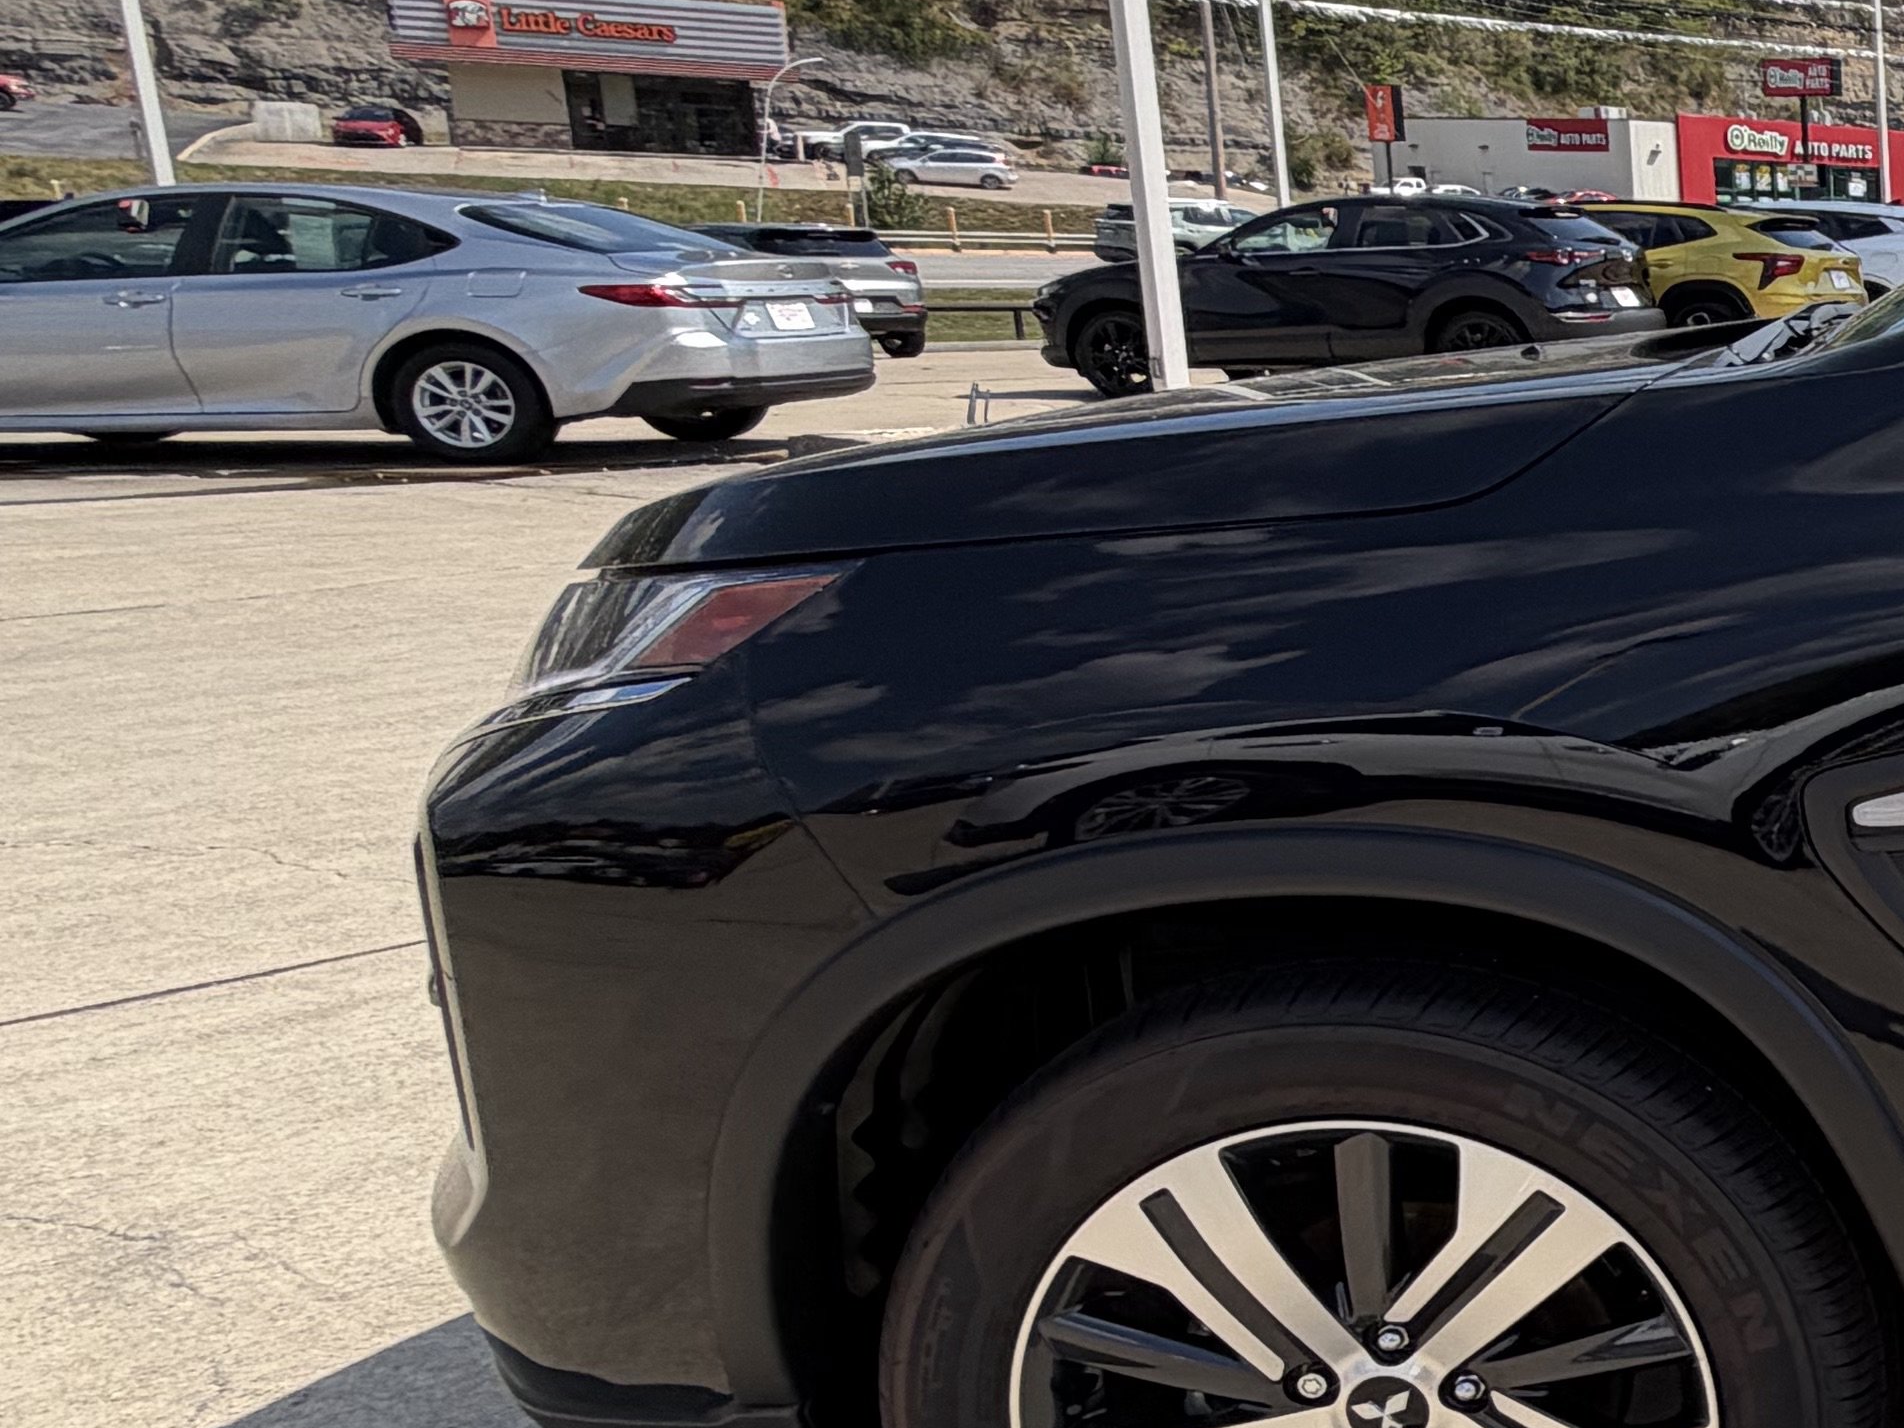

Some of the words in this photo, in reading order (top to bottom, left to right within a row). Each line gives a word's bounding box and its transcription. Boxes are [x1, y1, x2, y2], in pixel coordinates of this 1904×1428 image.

[500, 7, 571, 35] Little
[576, 11, 677, 44] Caesars
[1728, 125, 1788, 155] O'Reilly
[1831, 144, 1873, 160] PARTS
[1500, 1081, 1781, 1354] NEXEN
